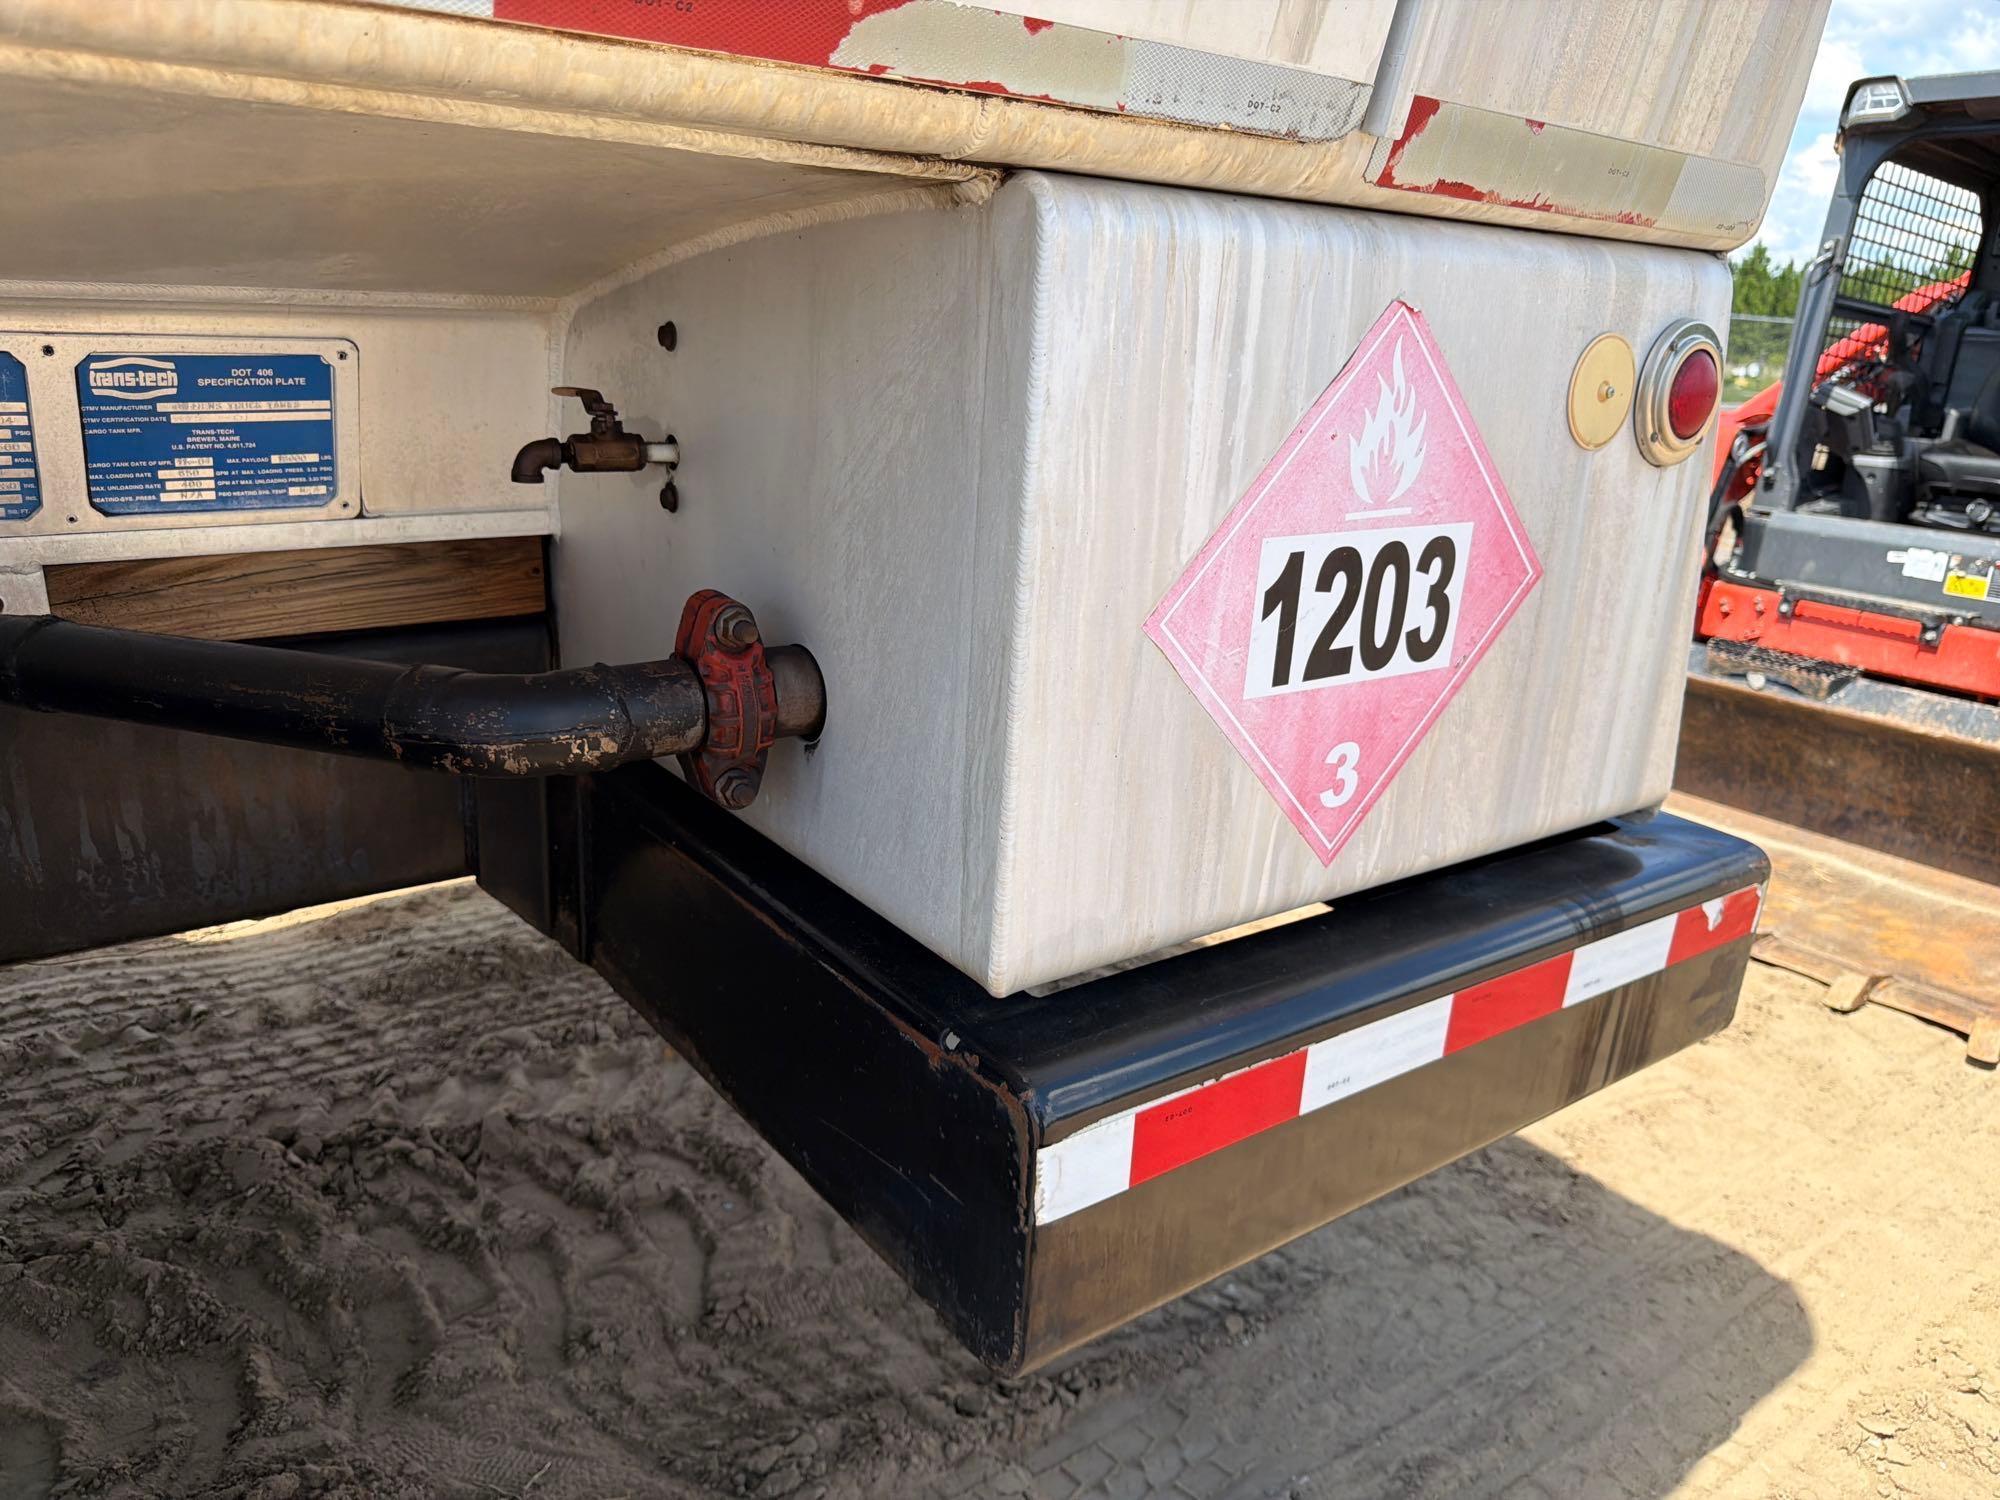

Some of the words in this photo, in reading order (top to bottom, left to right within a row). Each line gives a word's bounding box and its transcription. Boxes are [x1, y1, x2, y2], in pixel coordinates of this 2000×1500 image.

[1247, 99, 1281, 113] DOT-C2
[231, 368, 252, 377] DOT
[256, 368, 274, 376] 406
[197, 377, 273, 387] SPECIFICATION
[275, 377, 306, 386] PLATE
[192, 428, 235, 436] TRANS-TECH
[1260, 535, 1457, 688] 1203
[1320, 741, 1360, 808] 3
